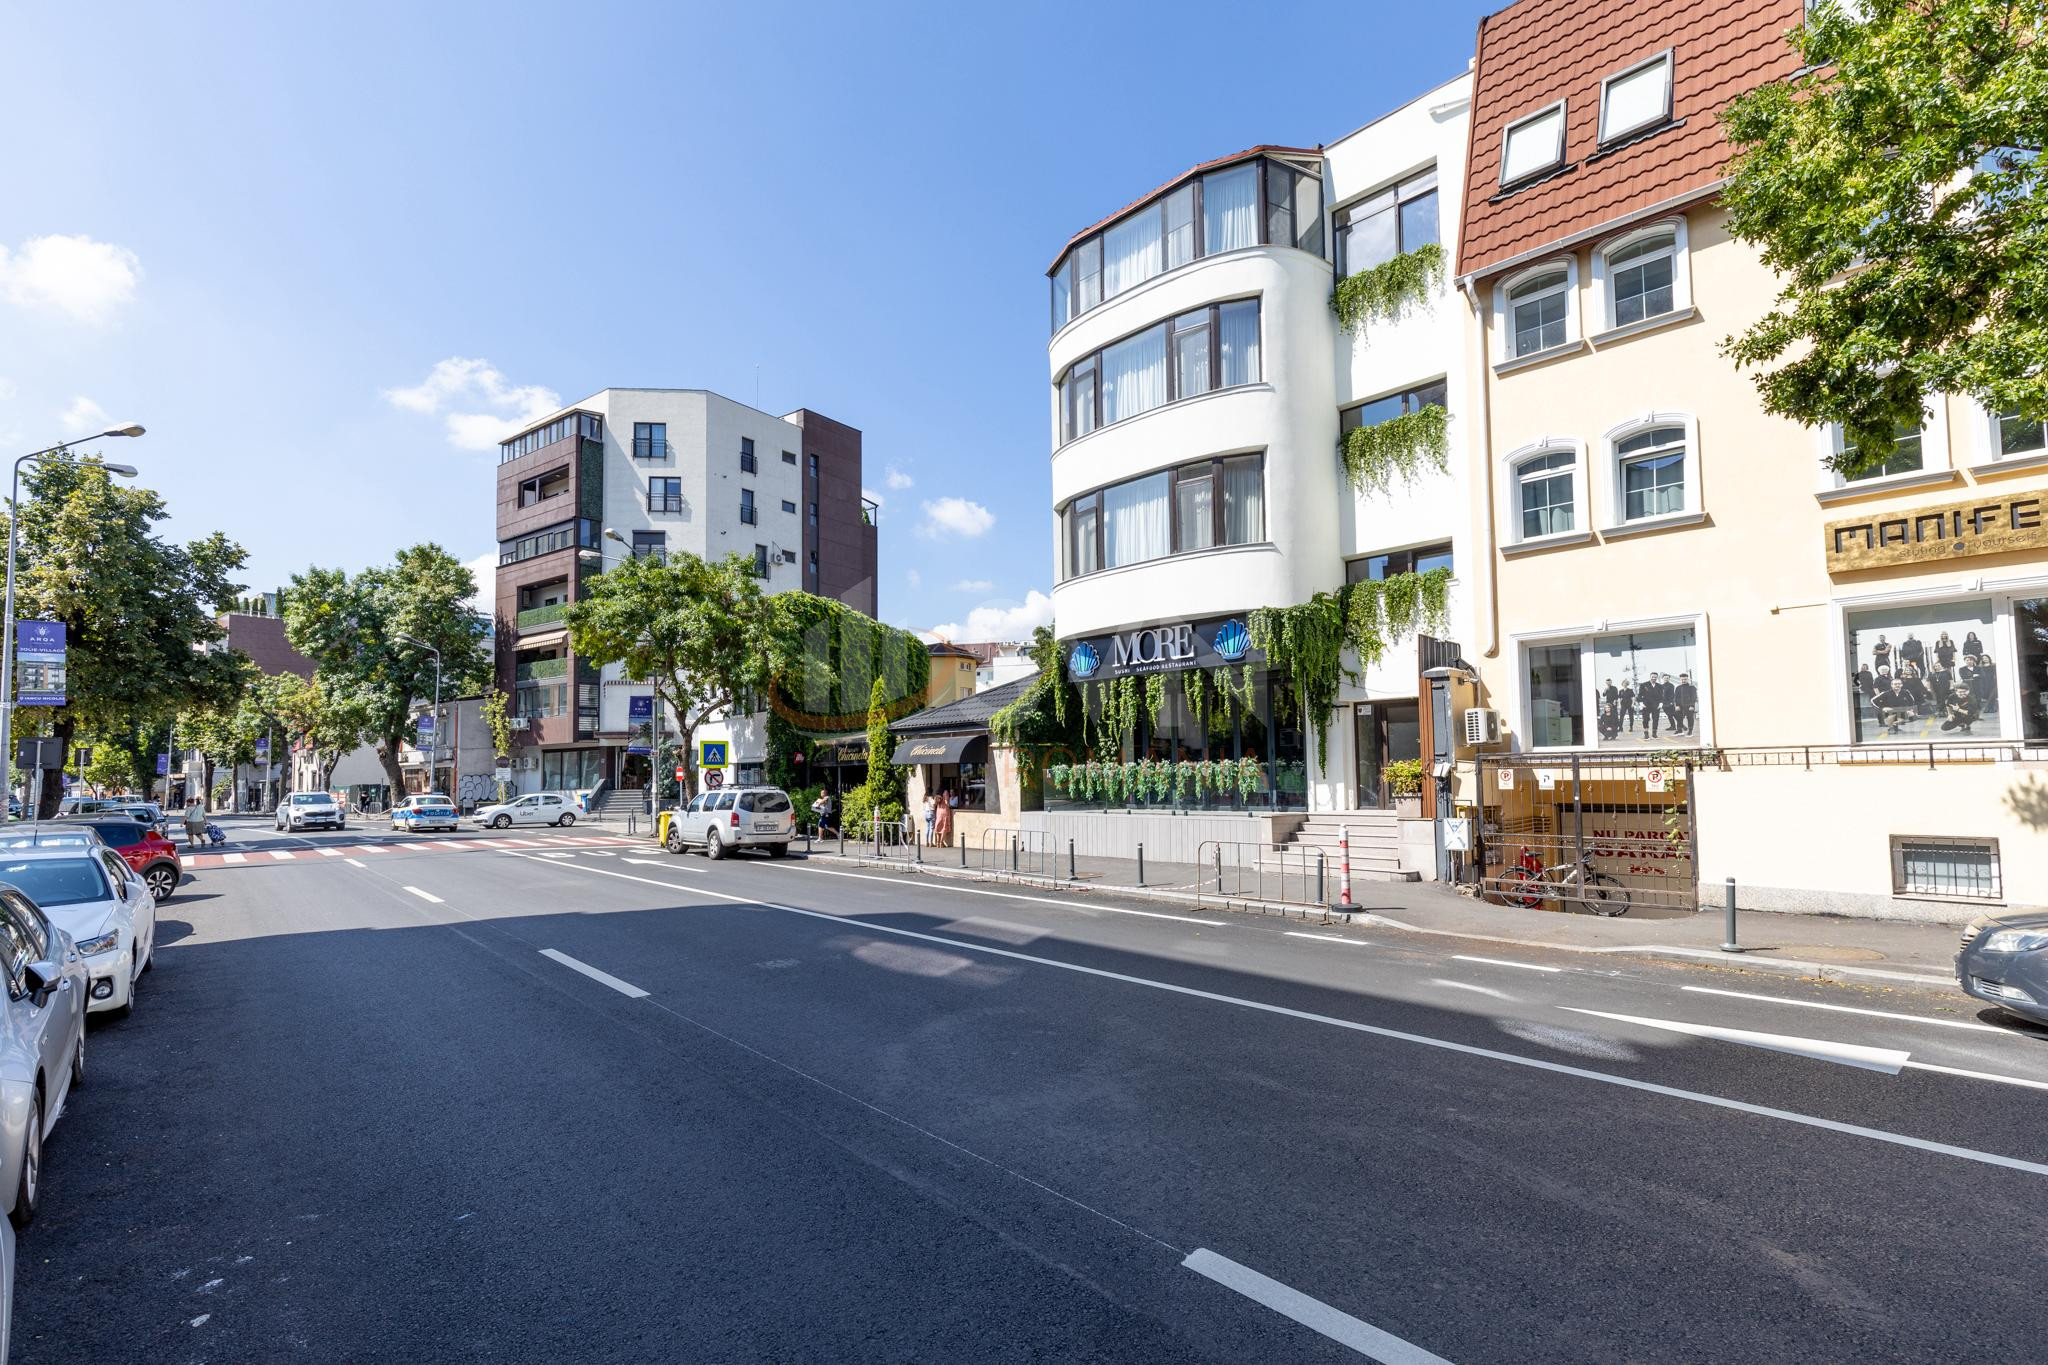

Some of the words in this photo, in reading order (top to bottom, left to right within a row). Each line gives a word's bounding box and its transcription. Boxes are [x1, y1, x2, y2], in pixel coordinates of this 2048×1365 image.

[1899, 544, 1946, 559] styling
[1973, 531, 2038, 549] yourself
[1112, 624, 1194, 667] MORE
[1136, 664, 1160, 673] SEAFOOD
[1161, 660, 1197, 669] RESTAURANT
[1593, 830, 1617, 839] NU
